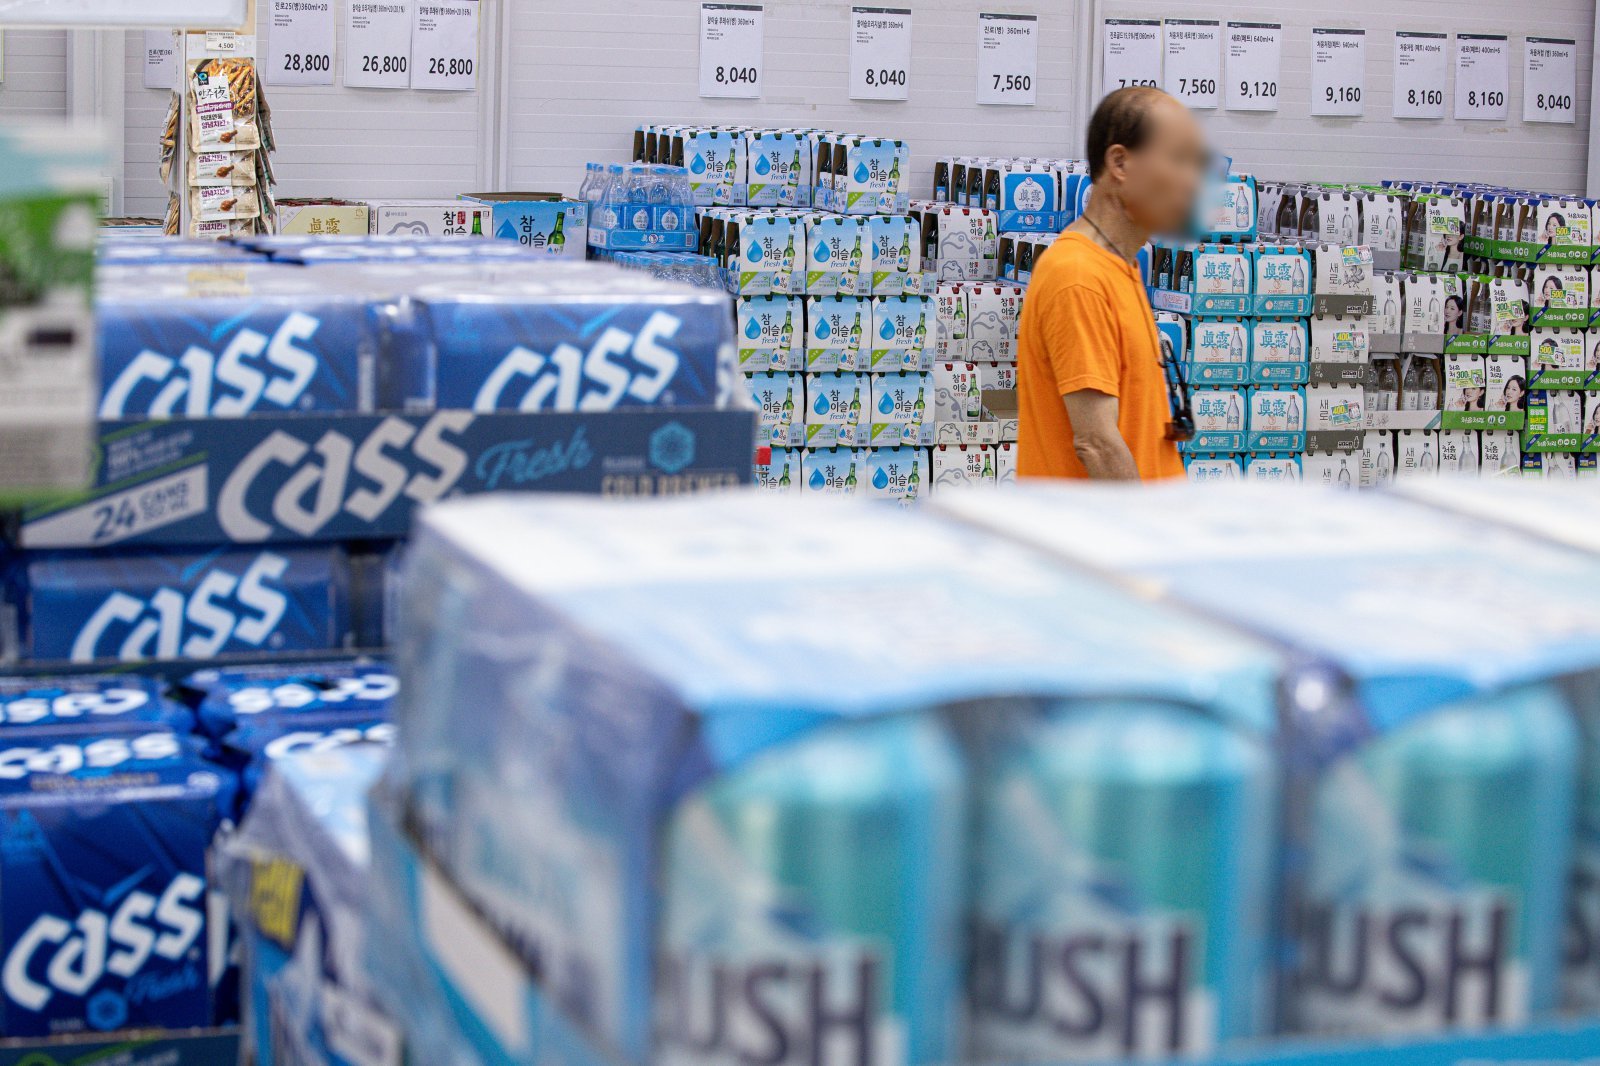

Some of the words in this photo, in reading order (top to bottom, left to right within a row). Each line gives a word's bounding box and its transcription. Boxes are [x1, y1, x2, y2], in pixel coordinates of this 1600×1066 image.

[285, 54, 329, 73] 28,800
[363, 56, 407, 74] 26,800
[429, 58, 472, 76] 26,800
[716, 66, 757, 86] 8,040
[866, 69, 906, 87] 8,040
[993, 74, 1031, 92] 7,560
[1179, 78, 1215, 96] 7,560
[1240, 82, 1276, 98] 9,120
[1326, 87, 1361, 104] 9,160
[1408, 90, 1442, 107] 8,160
[1468, 91, 1503, 108] 8,160
[1537, 94, 1571, 111] 8,040
[706, 150, 716, 161] 참
[770, 152, 780, 162] 참
[707, 161, 724, 172] 이슬
[771, 162, 789, 173] 이슬
[870, 159, 879, 170] 참
[870, 170, 887, 181] 이슬
[443, 211, 456, 226] 참
[520, 215, 535, 232] 참
[970, 218, 977, 227] 참
[520, 232, 546, 248] 이슬
[763, 237, 773, 248] 참
[831, 237, 841, 249] 참
[880, 235, 890, 247] 참
[764, 248, 782, 260] 이슬
[831, 248, 849, 260] 이슬
[880, 246, 898, 258] 이슬
[1203, 261, 1231, 280] 眞露
[1264, 262, 1291, 281] 眞露
[939, 297, 946, 306] 참
[1001, 298, 1008, 307] 참
[761, 313, 771, 325] 참
[831, 314, 841, 326] 참
[896, 315, 906, 327] 참
[762, 324, 780, 336] 이슬
[832, 326, 849, 337] 이슬
[896, 326, 914, 338] 이슬
[1201, 330, 1230, 349] 眞露
[1260, 330, 1288, 349] 眞露
[953, 374, 960, 383] 참
[998, 370, 1005, 379] 참
[763, 390, 773, 402] 참
[830, 390, 840, 401] 참
[895, 389, 904, 401] 참
[764, 401, 781, 413] 이슬
[830, 401, 848, 412] 이슬
[895, 400, 913, 412] 이슬
[1198, 399, 1226, 417] 眞露
[1258, 399, 1286, 417] 眞露
[475, 424, 595, 490] Fresh
[967, 454, 974, 463] 참
[826, 465, 836, 477] 참
[889, 464, 898, 476] 참
[826, 476, 844, 488] 이슬
[889, 474, 907, 486] 이슬
[93, 498, 138, 540] 24
